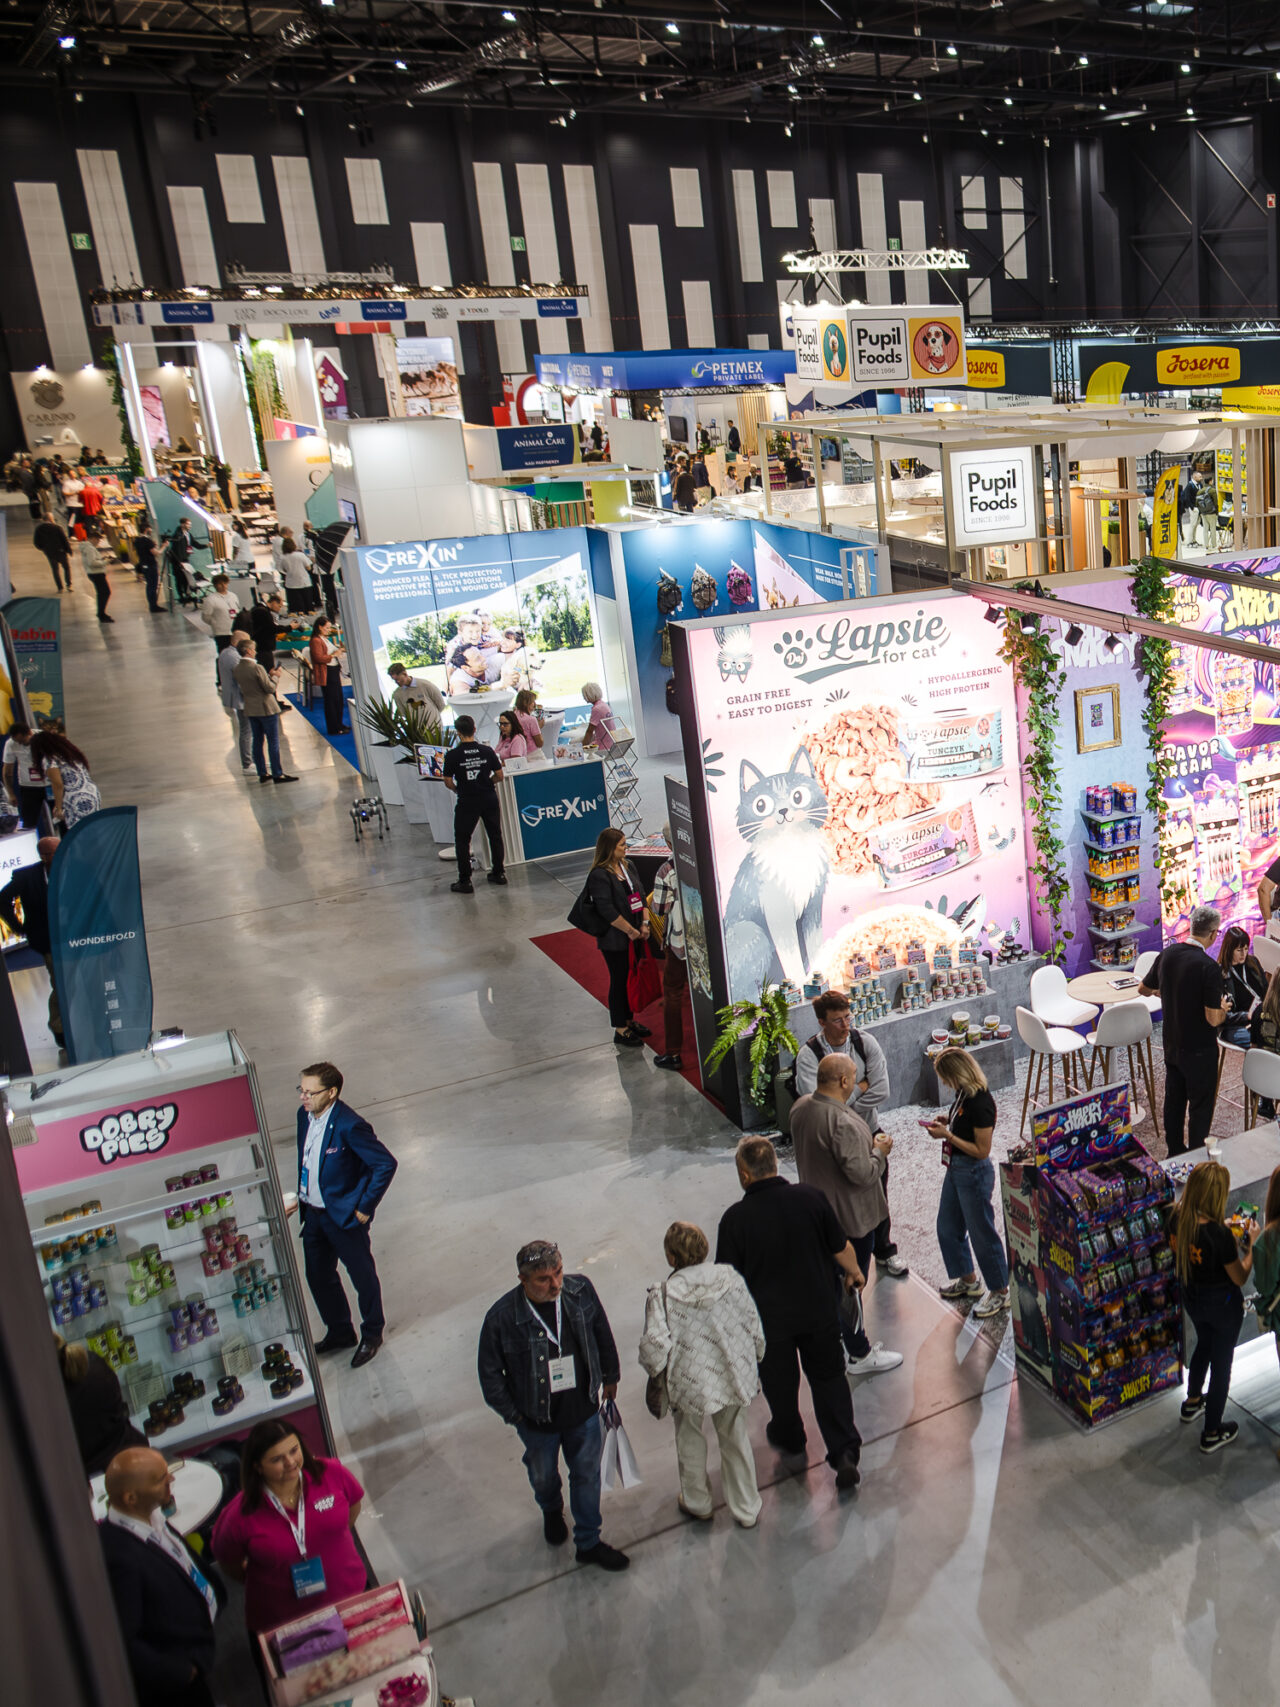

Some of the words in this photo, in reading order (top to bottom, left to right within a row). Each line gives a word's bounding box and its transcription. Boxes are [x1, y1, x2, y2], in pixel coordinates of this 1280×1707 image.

[797, 327, 818, 353] Pupil
[857, 327, 902, 353] Pupil
[799, 349, 819, 365] Foods
[859, 347, 902, 365] Foods
[1166, 353, 1230, 374] Josera
[712, 361, 764, 376] PETMEX
[967, 357, 998, 375] osera
[514, 440, 544, 448] ANIMAL
[545, 438, 566, 446] CARE
[968, 468, 1017, 496] Pupil
[970, 493, 1017, 513] Foods
[1159, 510, 1171, 544] bult
[373, 577, 411, 587] ADVANCED
[412, 575, 429, 583] FLEA
[459, 568, 503, 578] PROTECTION
[374, 584, 417, 594] INNOVATIVE
[434, 580, 462, 588] HEALTH
[463, 576, 501, 584] SOLUTIONS
[375, 590, 432, 601] PROFESSIONAL
[437, 587, 454, 595] SKIN
[462, 584, 488, 592] WOUND
[816, 610, 946, 661] Lapsie
[883, 650, 906, 664] for
[912, 646, 937, 660] cat
[928, 665, 1003, 685] HYPOALLERGENIC
[726, 691, 762, 706] GRAIN
[764, 688, 791, 701] FREE
[929, 687, 952, 699] HIGH
[953, 681, 990, 697] PROTEIN
[728, 707, 758, 720] EASY
[759, 704, 773, 716] TO
[775, 698, 814, 713] DIGEST
[1157, 739, 1220, 763] FLAVOR
[466, 770, 480, 780] B7
[538, 796, 597, 820] FREXIN
[0, 856, 22, 869] ARE
[68, 930, 136, 948] WONDERFOLD
[1068, 1101, 1102, 1121] HAPPY
[84, 1103, 176, 1148] DOBRY
